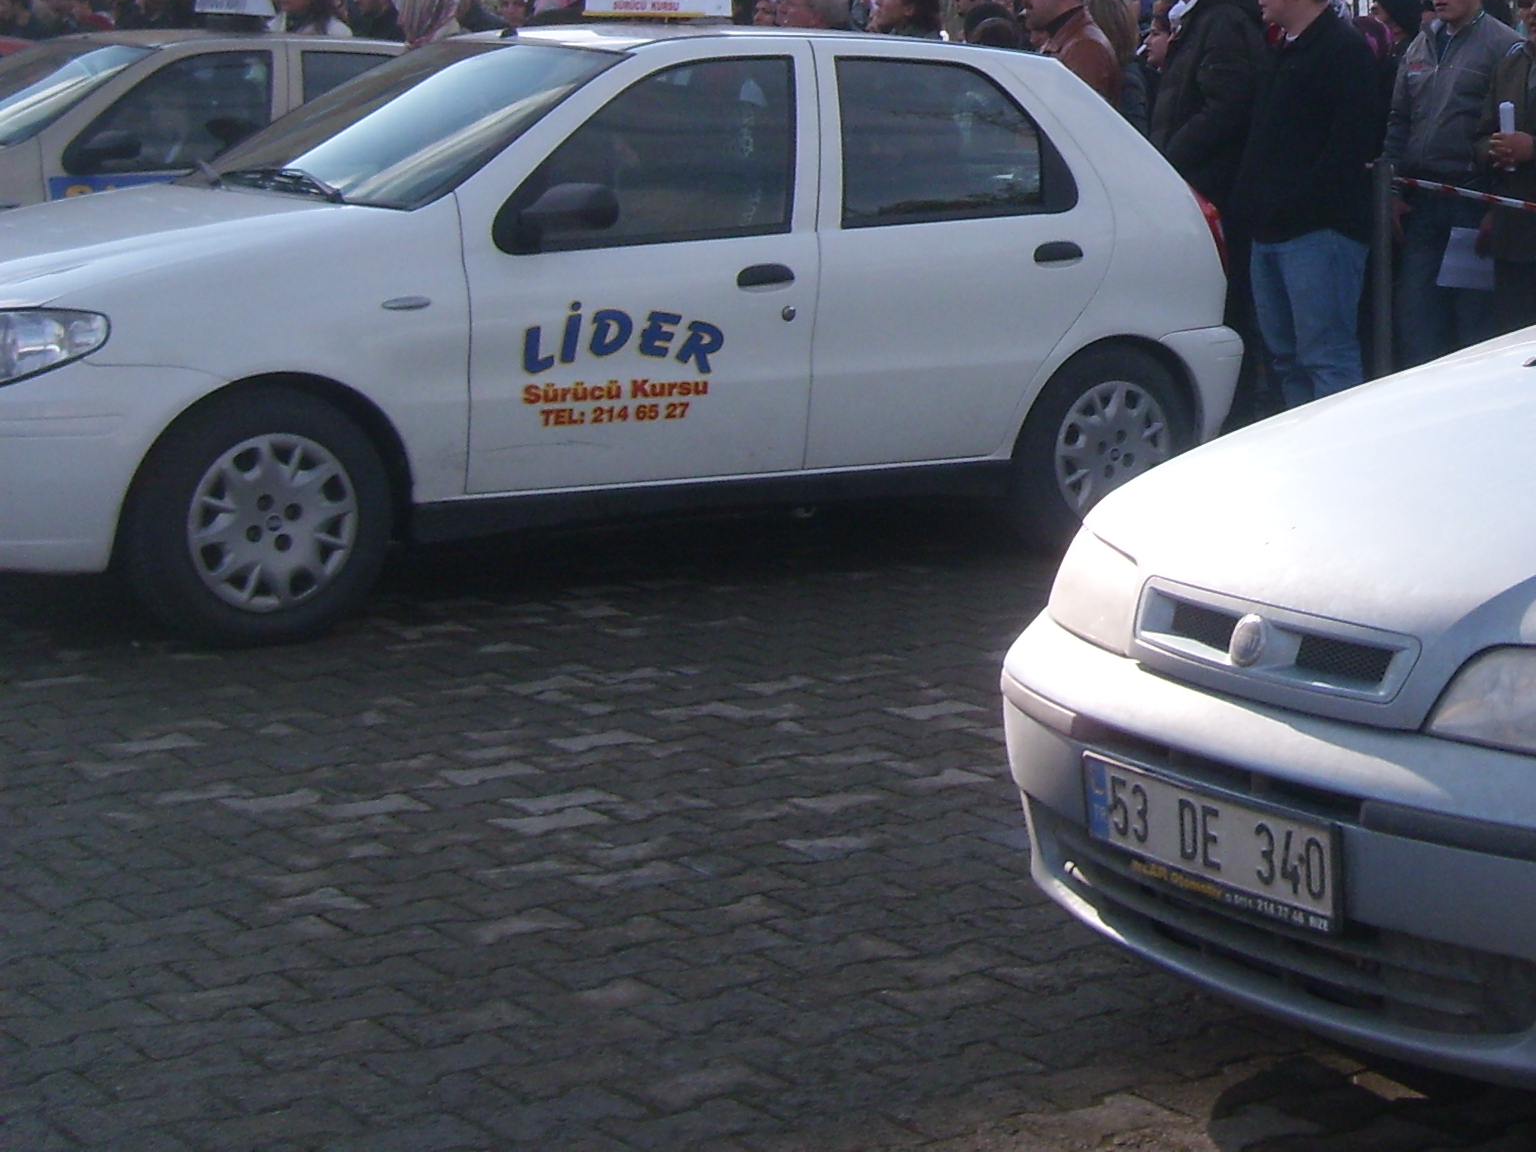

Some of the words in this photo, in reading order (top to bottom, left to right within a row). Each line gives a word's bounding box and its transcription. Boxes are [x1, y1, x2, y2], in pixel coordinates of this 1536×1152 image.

[523, 379, 622, 405] Sürücü
[630, 378, 709, 399] Kursu
[539, 408, 585, 427] TEL:
[590, 405, 630, 425] 214
[635, 403, 659, 421] 65
[664, 401, 690, 420] 27
[1109, 774, 1150, 844] 53
[1178, 797, 1222, 873] DE
[1254, 821, 1327, 901] 340
